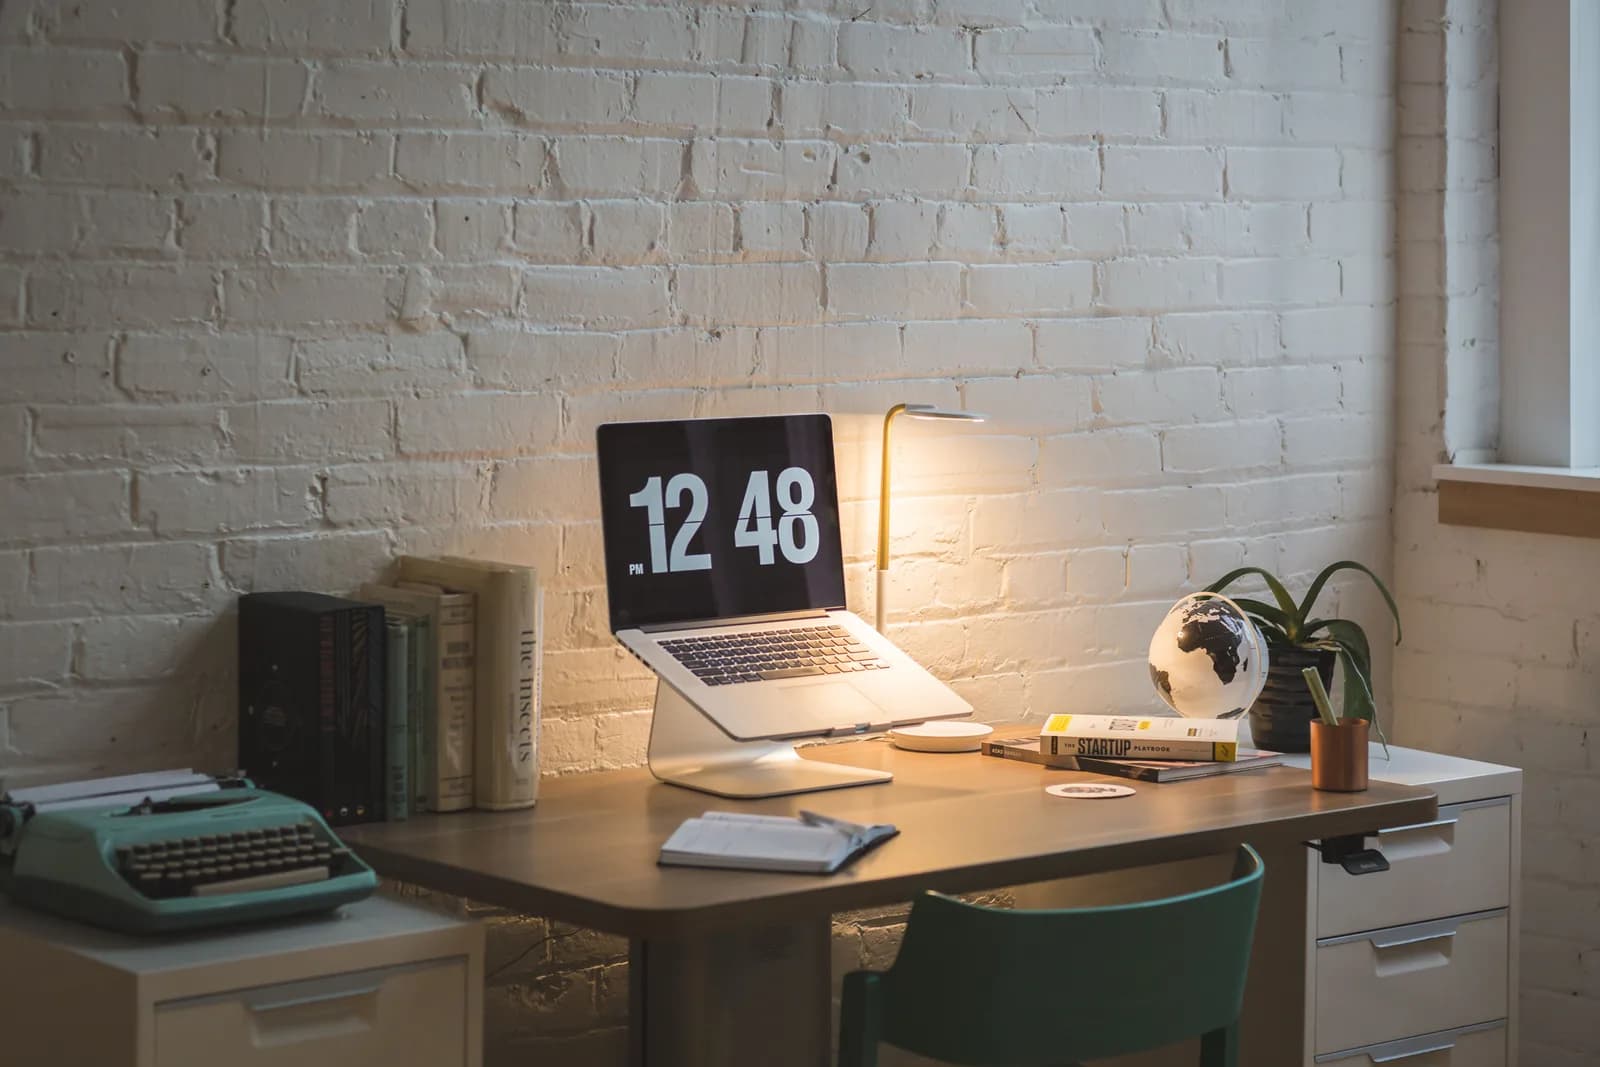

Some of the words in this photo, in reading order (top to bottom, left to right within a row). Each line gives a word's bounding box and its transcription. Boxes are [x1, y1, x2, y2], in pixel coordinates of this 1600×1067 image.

[629, 472, 713, 574] 12
[734, 466, 820, 566] 48
[629, 563, 644, 576] PM
[519, 629, 536, 670] the
[518, 676, 534, 763] insects
[1078, 737, 1131, 756] STARTUP
